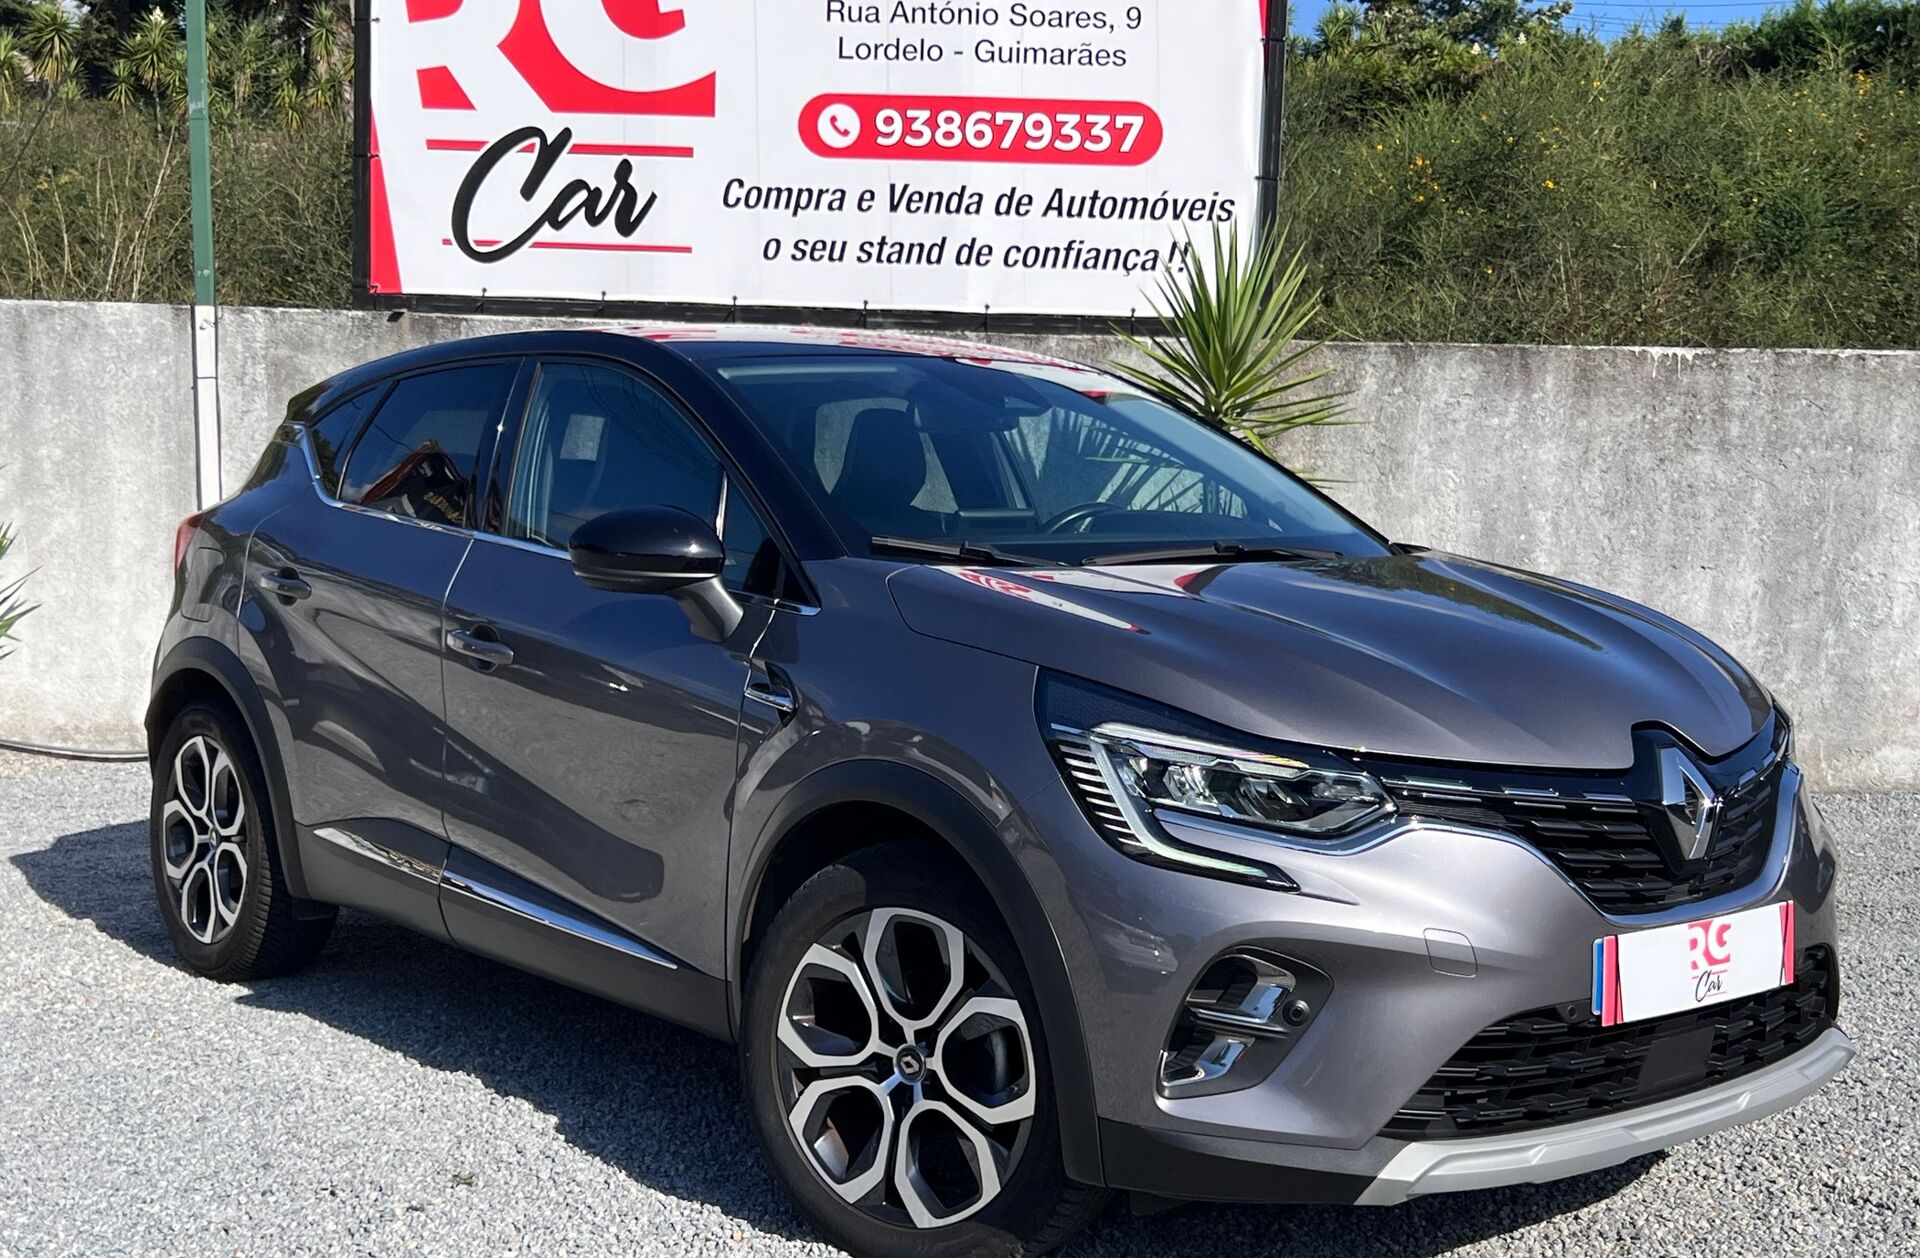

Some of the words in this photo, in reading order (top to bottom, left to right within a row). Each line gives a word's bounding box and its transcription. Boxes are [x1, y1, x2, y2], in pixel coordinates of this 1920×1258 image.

[826, 0, 881, 24] Rua
[889, 0, 999, 26] António
[1009, 3, 1116, 34] Soares,
[1126, 6, 1142, 30] 9
[838, 36, 944, 62] Lordelo
[974, 39, 1127, 67] Guimarães
[875, 108, 1144, 153] 938679337
[451, 126, 658, 263] Car
[722, 178, 847, 218] Compra
[856, 189, 876, 213] e
[889, 183, 984, 216] Venda
[994, 186, 1034, 217] de
[1041, 187, 1236, 223] Automóveis
[762, 237, 782, 261] o
[790, 238, 848, 263] seu
[856, 235, 948, 265] stand
[955, 237, 993, 267] de
[1695, 969, 1723, 1003] Car
